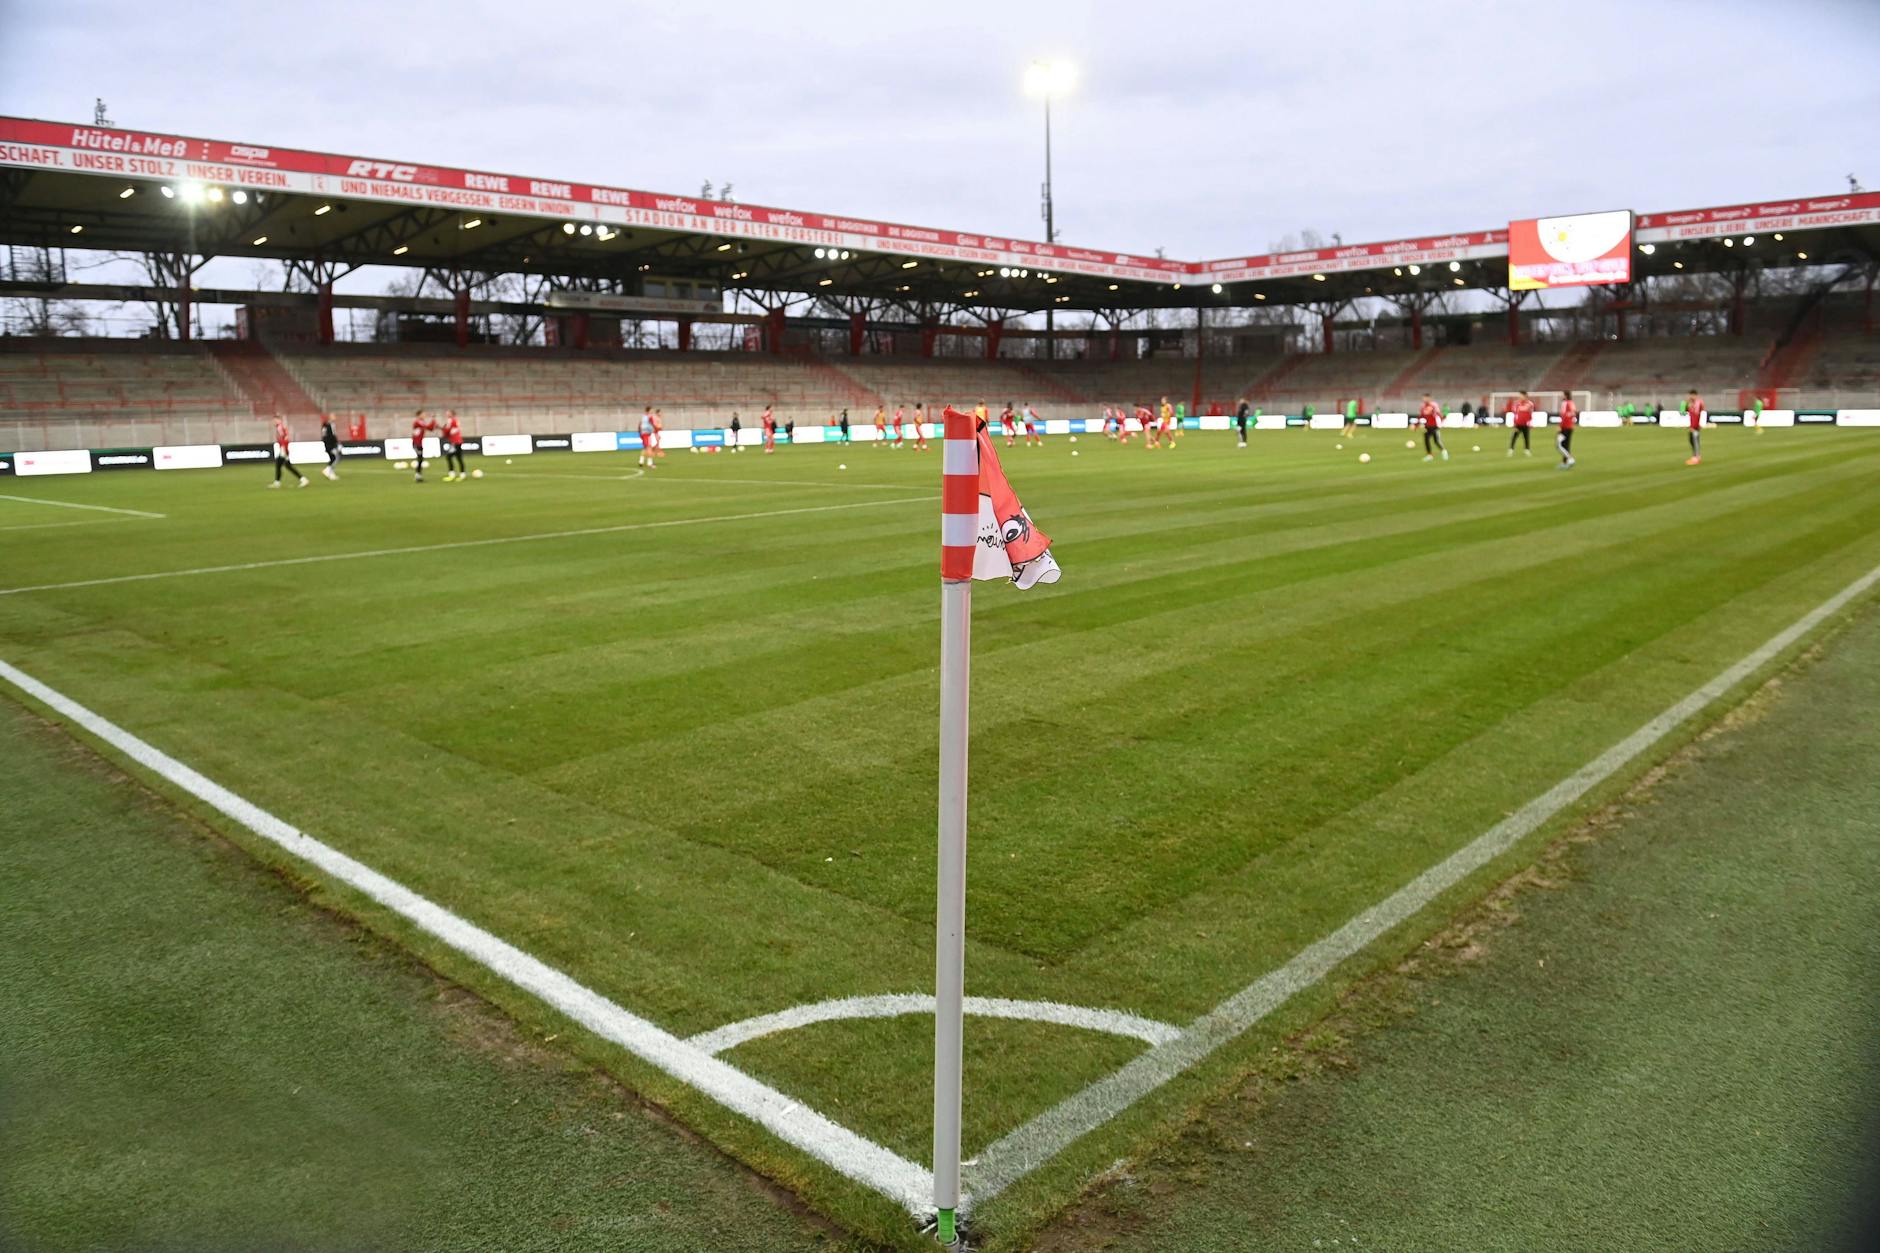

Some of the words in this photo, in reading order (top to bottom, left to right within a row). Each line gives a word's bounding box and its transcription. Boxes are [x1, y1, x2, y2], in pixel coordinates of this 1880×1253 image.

[72, 152, 124, 171] UNSER
[187, 163, 235, 182] UNSER
[346, 159, 418, 181] RTC
[341, 180, 368, 195] UND
[370, 182, 423, 201] NIEMALS
[464, 173, 509, 192] REWE
[530, 181, 572, 199] REWE
[591, 188, 630, 205] REWE
[655, 198, 697, 214] wefox
[713, 205, 753, 220] wefox
[625, 208, 685, 227] STADION
[691, 216, 708, 230] AN
[714, 217, 738, 234] DER
[743, 222, 780, 238] ALTEN
[767, 212, 804, 226] wefox
